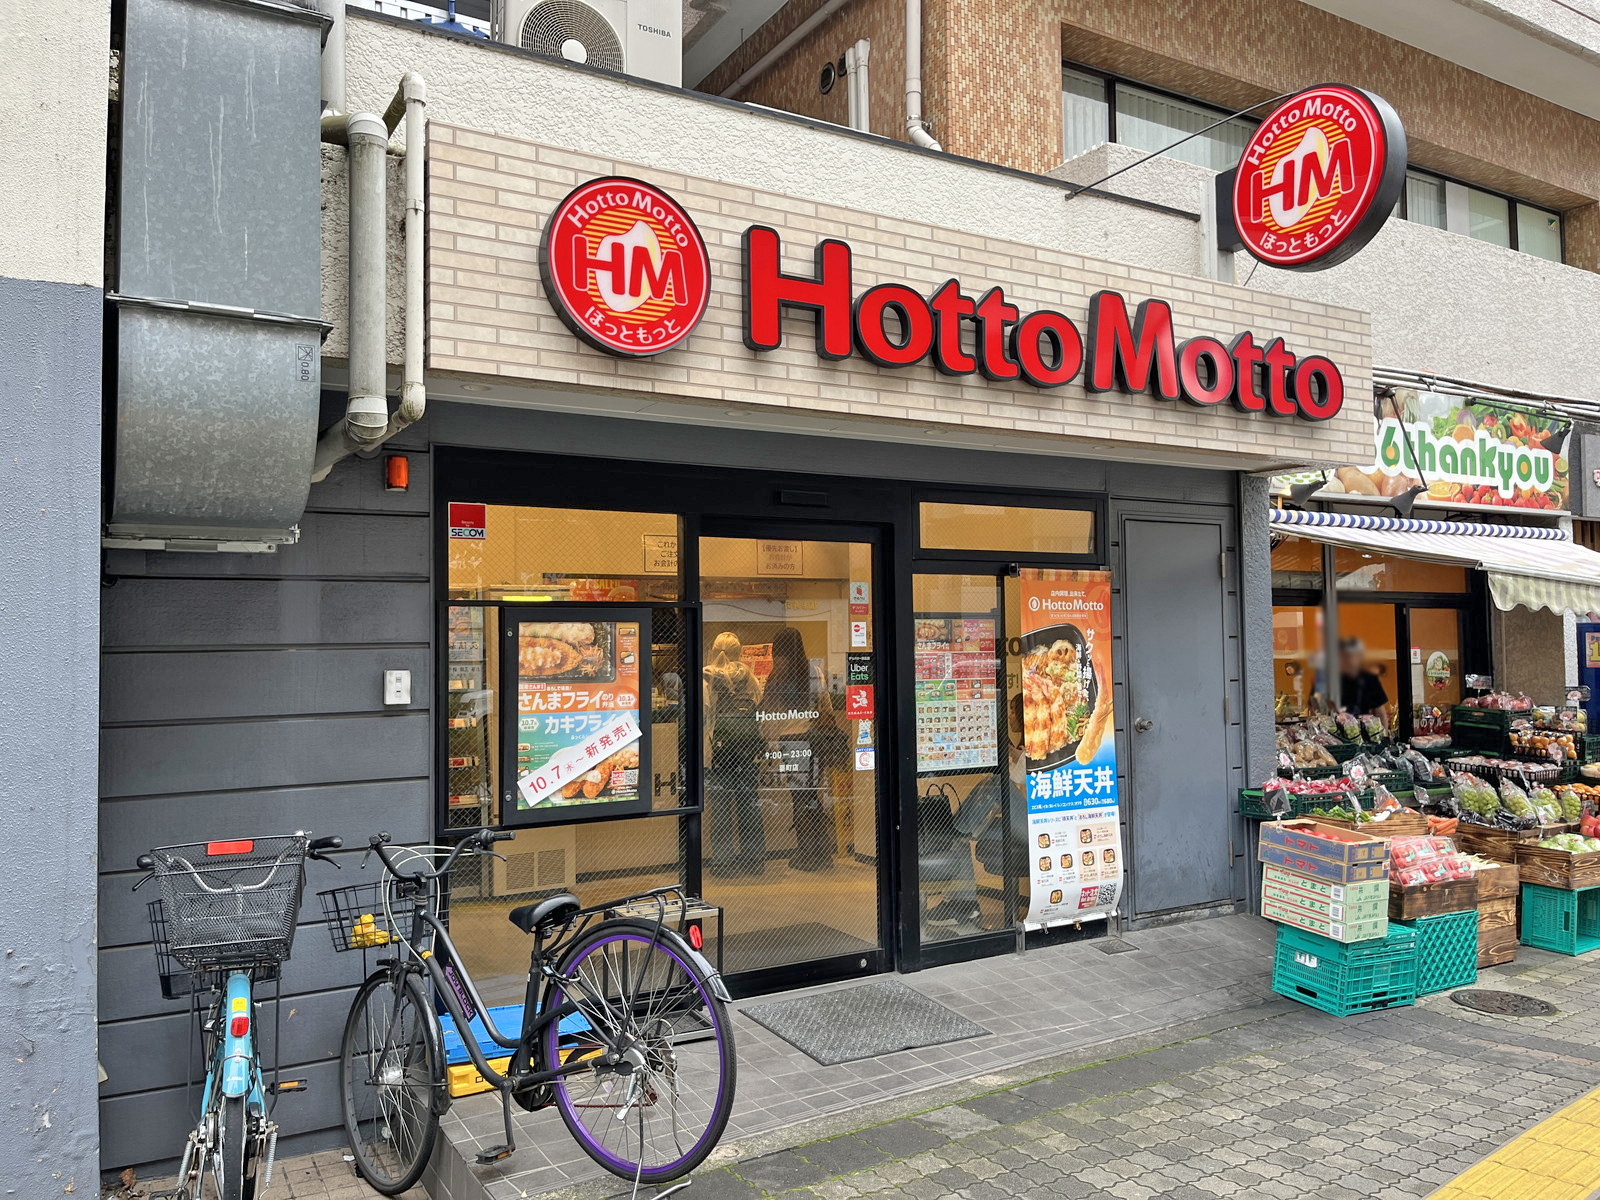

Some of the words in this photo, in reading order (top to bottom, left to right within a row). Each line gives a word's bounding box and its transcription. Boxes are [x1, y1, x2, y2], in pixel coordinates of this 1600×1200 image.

[637, 23, 672, 38] TOSHIBA
[1259, 209, 1348, 254] ほっともっと
[584, 305, 681, 344] ほっともっと
[451, 528, 485, 538] SECOM
[850, 663, 869, 672] Uber
[850, 672, 870, 681] Eats
[518, 690, 604, 711] さんまフライ
[1030, 766, 1115, 800] 海鮮天丼
[1284, 836, 1320, 853] トマト
[1283, 856, 1318, 871] トマト
[1300, 879, 1328, 894] とまと
[1299, 897, 1326, 912] とまと
[1299, 916, 1326, 931] とまと
